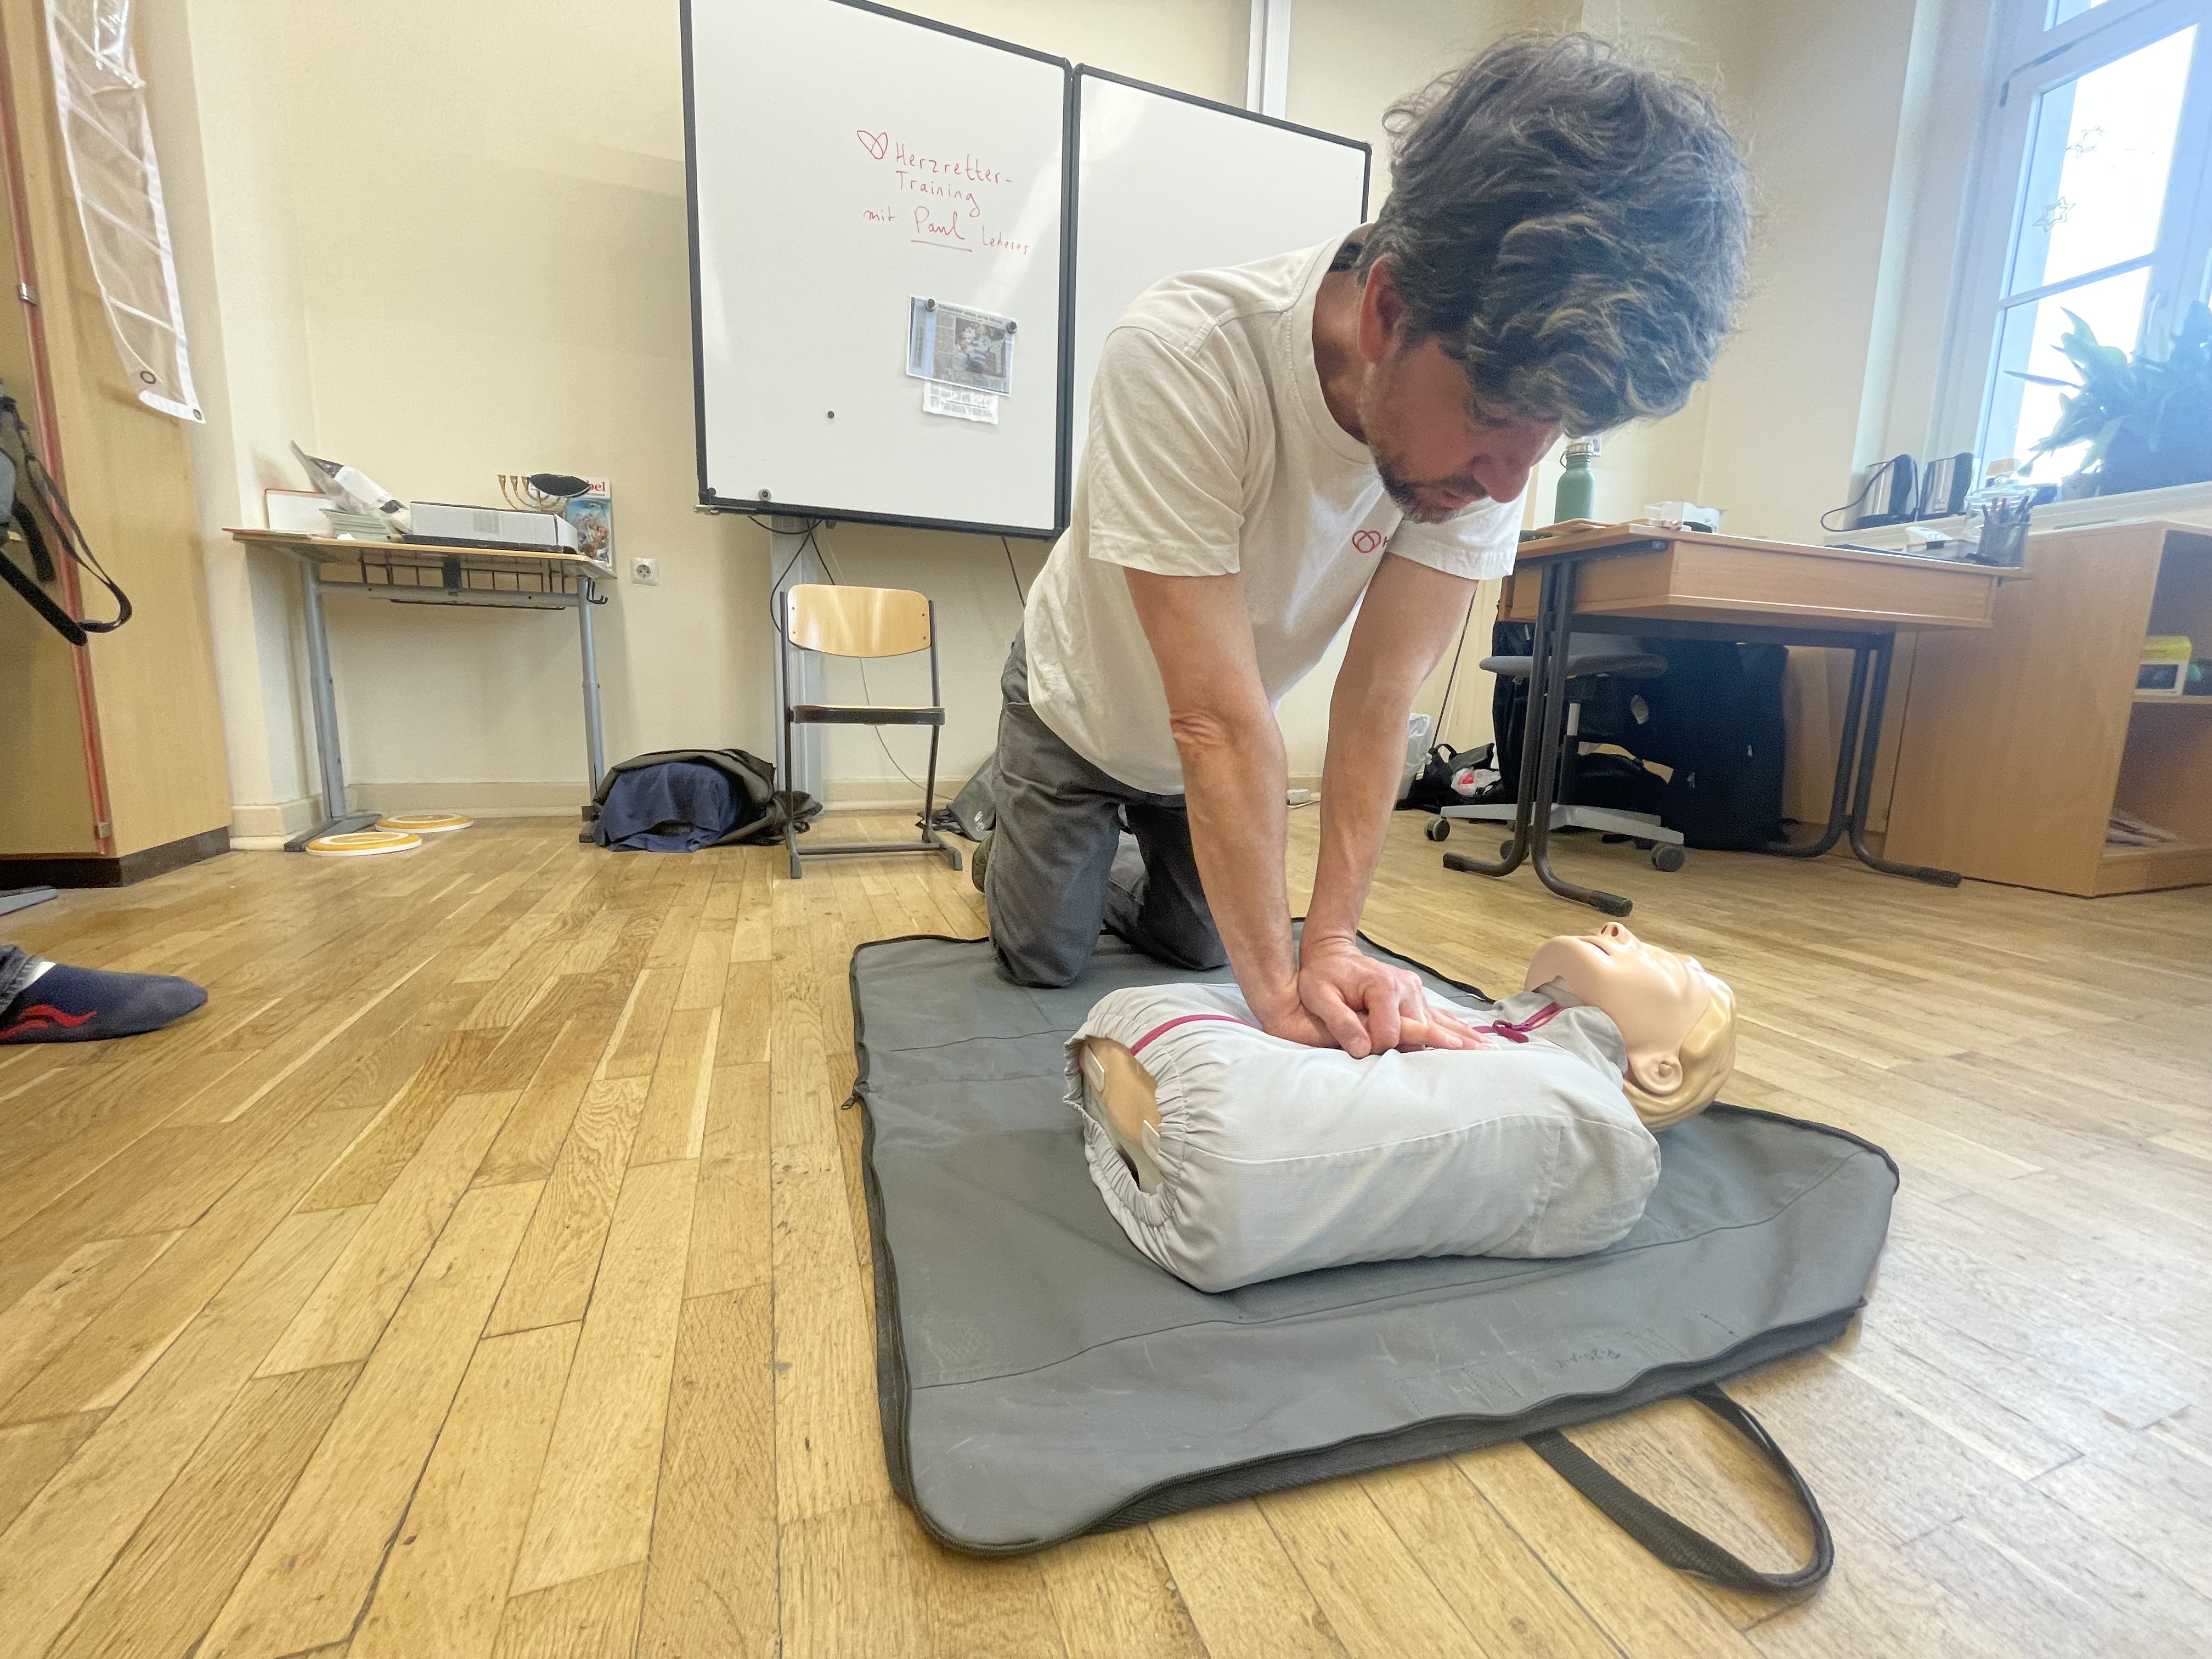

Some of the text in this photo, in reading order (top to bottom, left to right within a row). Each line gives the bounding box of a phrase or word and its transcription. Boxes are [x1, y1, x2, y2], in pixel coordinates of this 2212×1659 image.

[896, 142, 1013, 184] Herzretter-
[896, 170, 980, 218] Training
[863, 206, 896, 222] mit
[913, 206, 966, 240] Paul
